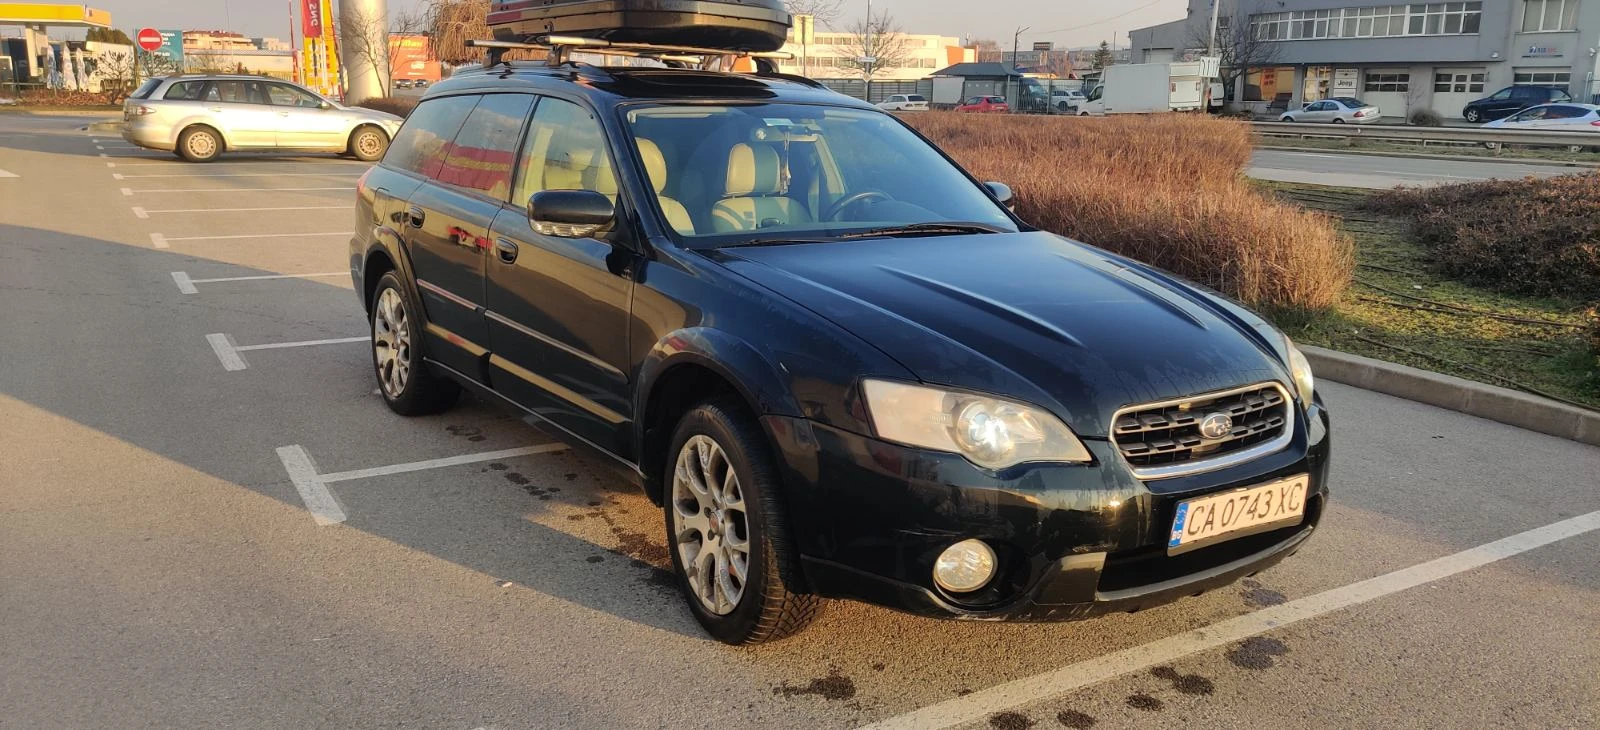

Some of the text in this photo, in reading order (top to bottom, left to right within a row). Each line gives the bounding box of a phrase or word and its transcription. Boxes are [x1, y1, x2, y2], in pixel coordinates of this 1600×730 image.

[1187, 482, 1303, 536] CA 0743 XC
